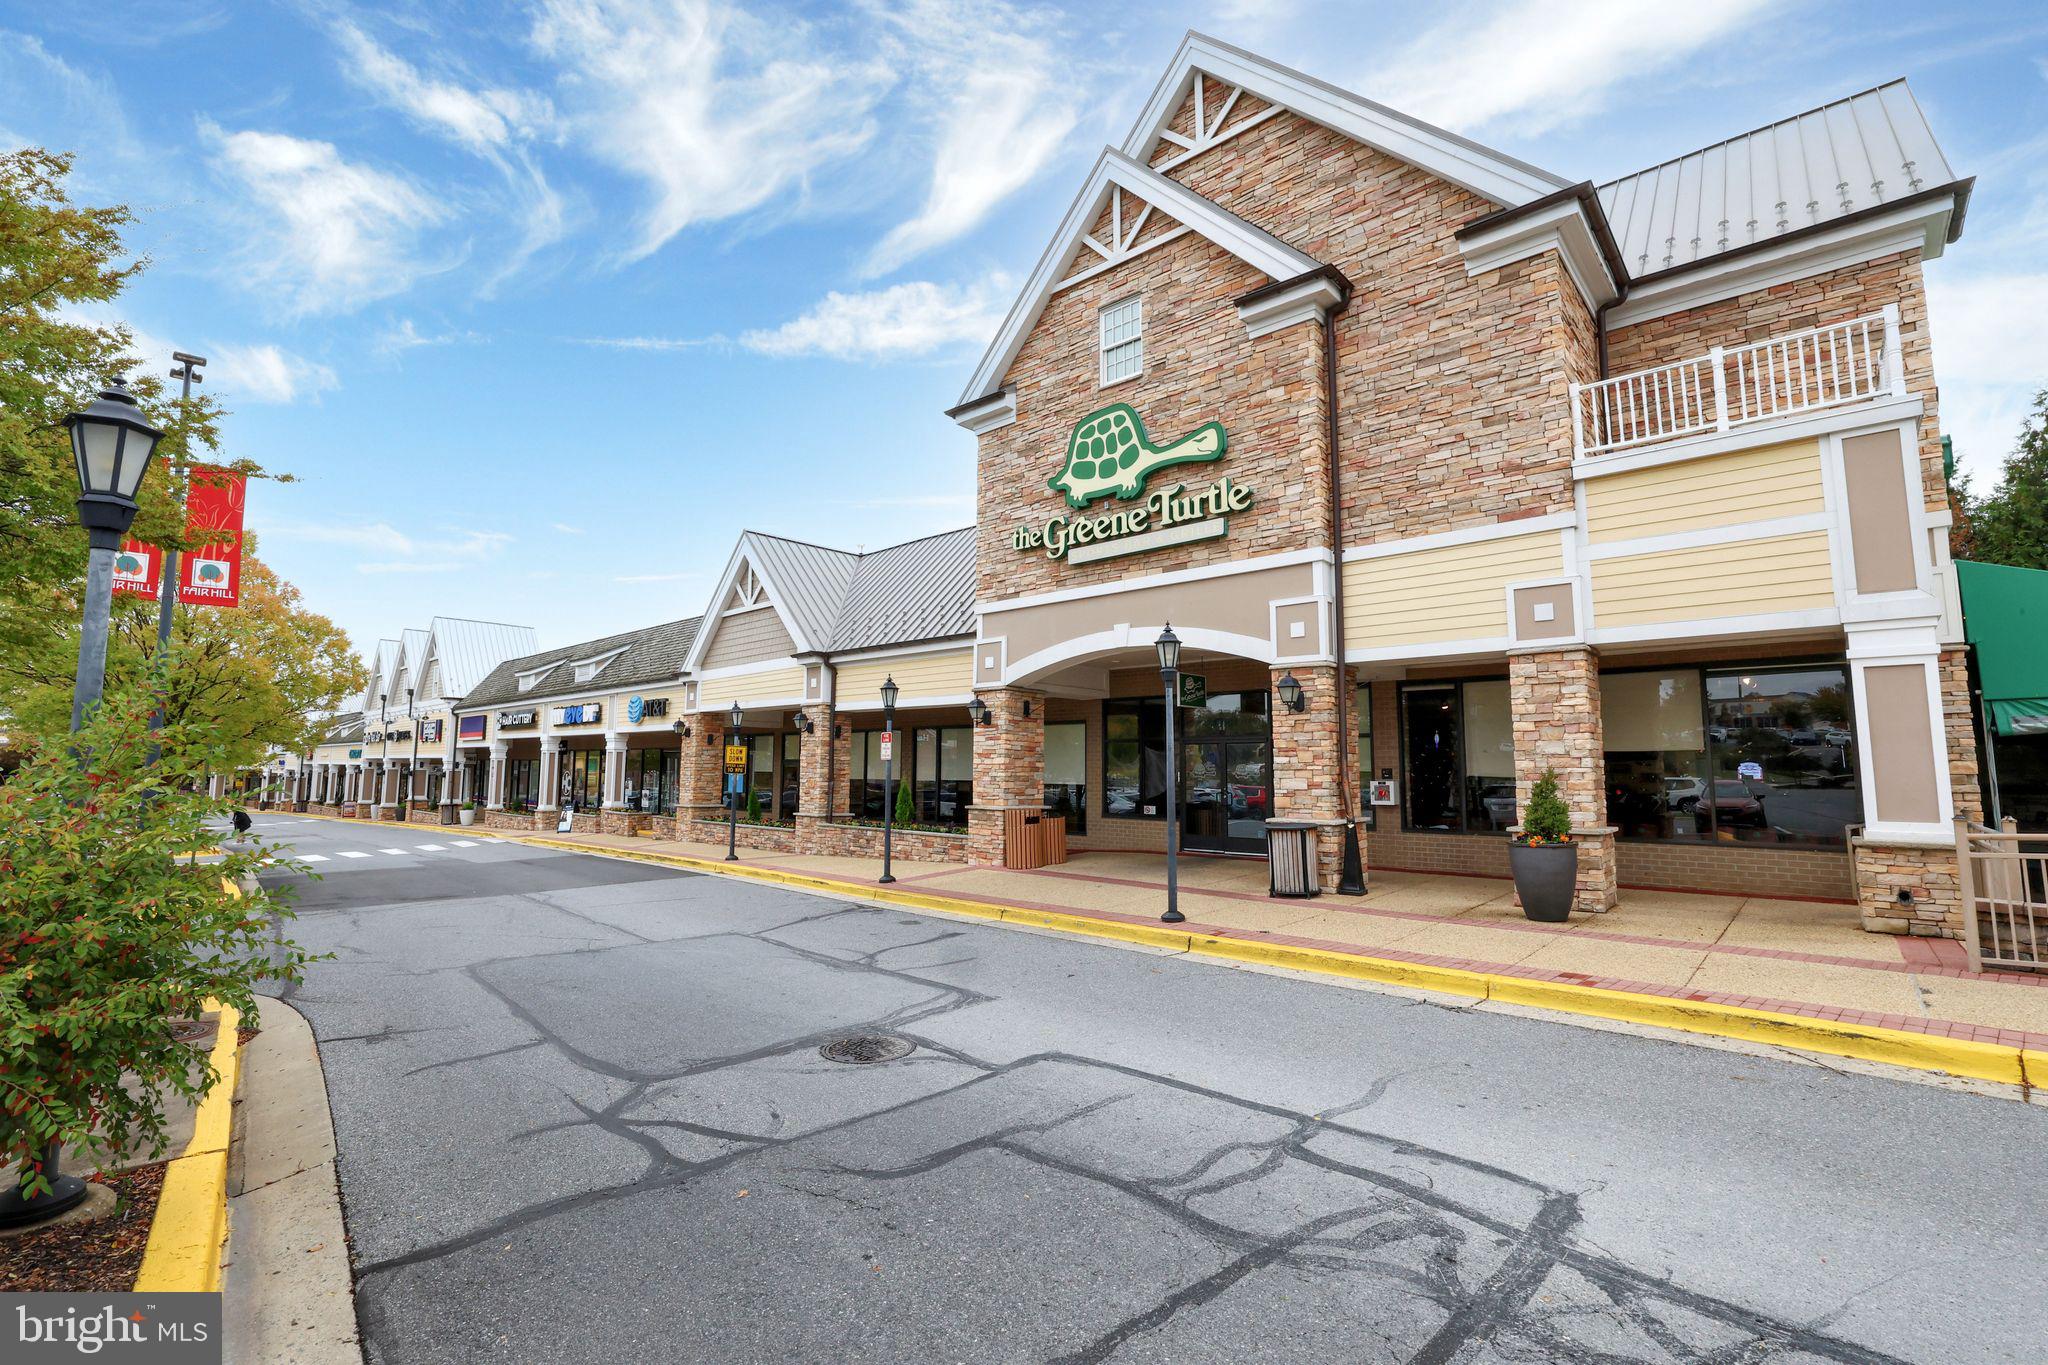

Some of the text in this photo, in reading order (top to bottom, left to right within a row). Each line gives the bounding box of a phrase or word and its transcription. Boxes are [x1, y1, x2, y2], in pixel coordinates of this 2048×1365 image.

[1012, 525, 1043, 550] the
[1043, 508, 1149, 560] Greene
[1147, 477, 1251, 527] Turtle
[112, 580, 153, 593] IR HILL
[183, 586, 235, 599] FAIR HILL
[641, 697, 668, 714] AT&T
